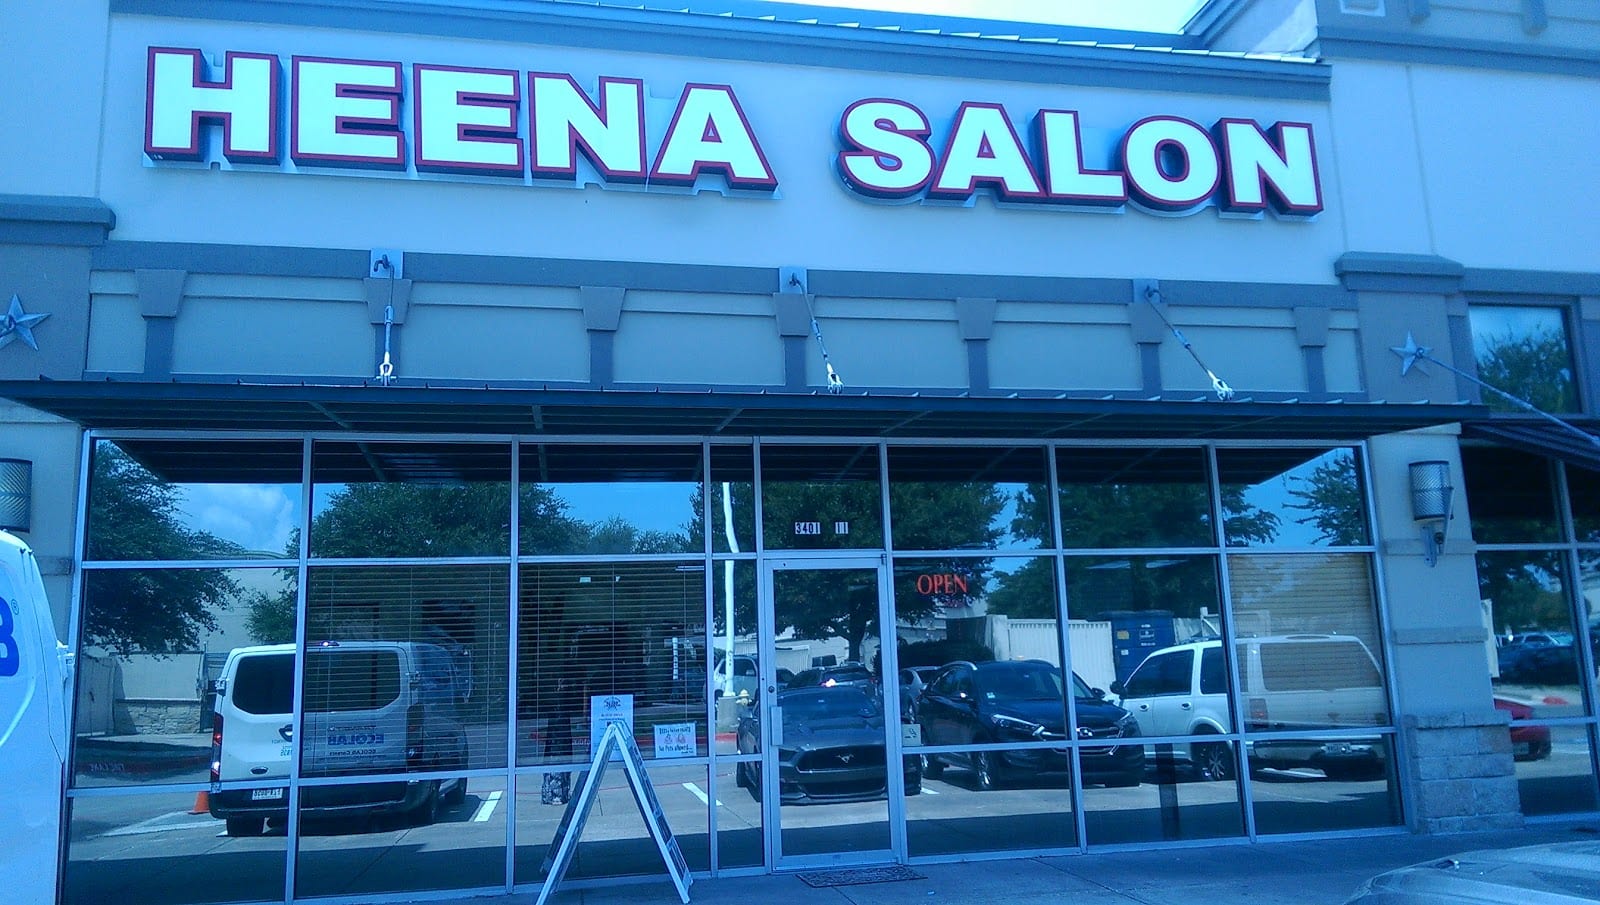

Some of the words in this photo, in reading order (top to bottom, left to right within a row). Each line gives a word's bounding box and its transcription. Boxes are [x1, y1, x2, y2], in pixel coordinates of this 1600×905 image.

[144, 46, 777, 192] HEENA
[837, 97, 1324, 216] SALON
[795, 522, 820, 534] 3401
[916, 574, 968, 595] OPEN
